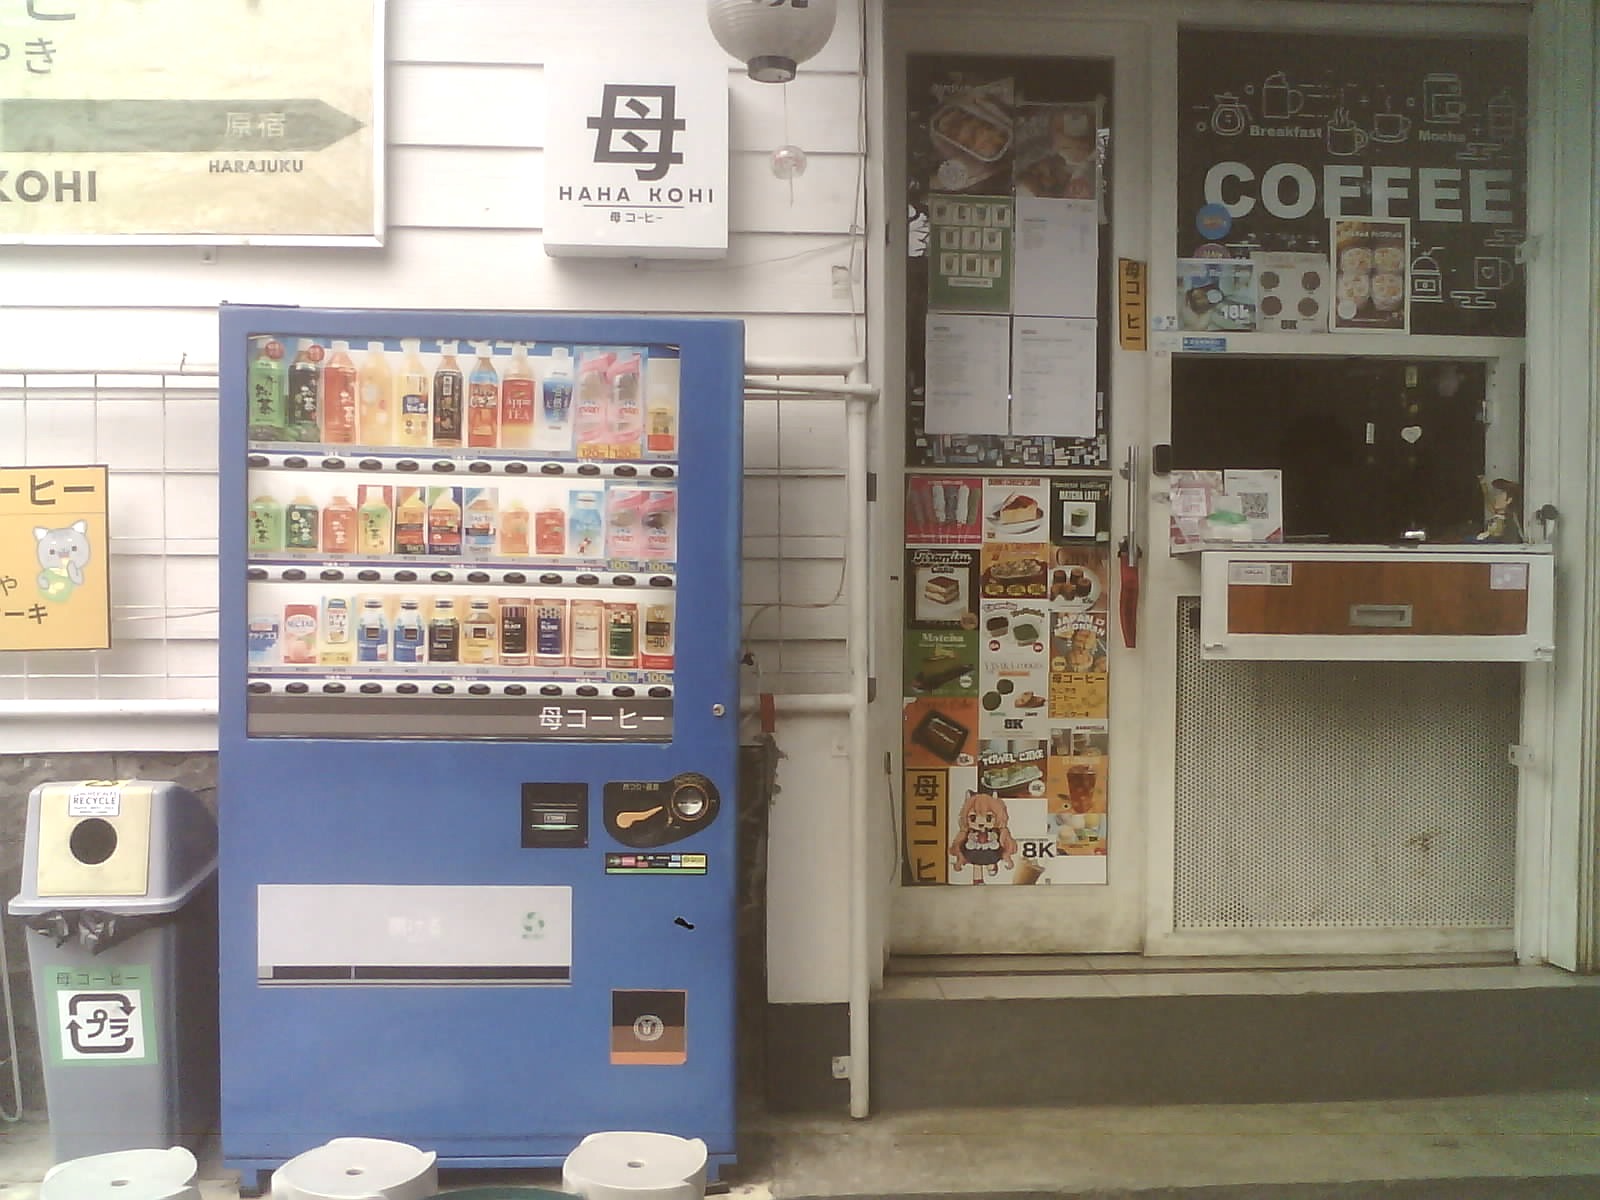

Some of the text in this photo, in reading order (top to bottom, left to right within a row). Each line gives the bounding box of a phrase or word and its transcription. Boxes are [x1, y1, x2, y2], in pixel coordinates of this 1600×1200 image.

[224, 112, 287, 138] 原宿
[586, 84, 686, 181] 母
[1250, 126, 1323, 139] Breakfast
[208, 159, 304, 174] HARAJUKU
[559, 186, 714, 204] HAHA KOHI
[1203, 161, 1514, 224] COFFEE
[539, 706, 665, 731] 母コーヒー
[73, 796, 117, 805] RECYCLE
[1022, 842, 1056, 858] 8K
[56, 971, 140, 986] 母コーヒー
[86, 1008, 129, 1039] プラ
